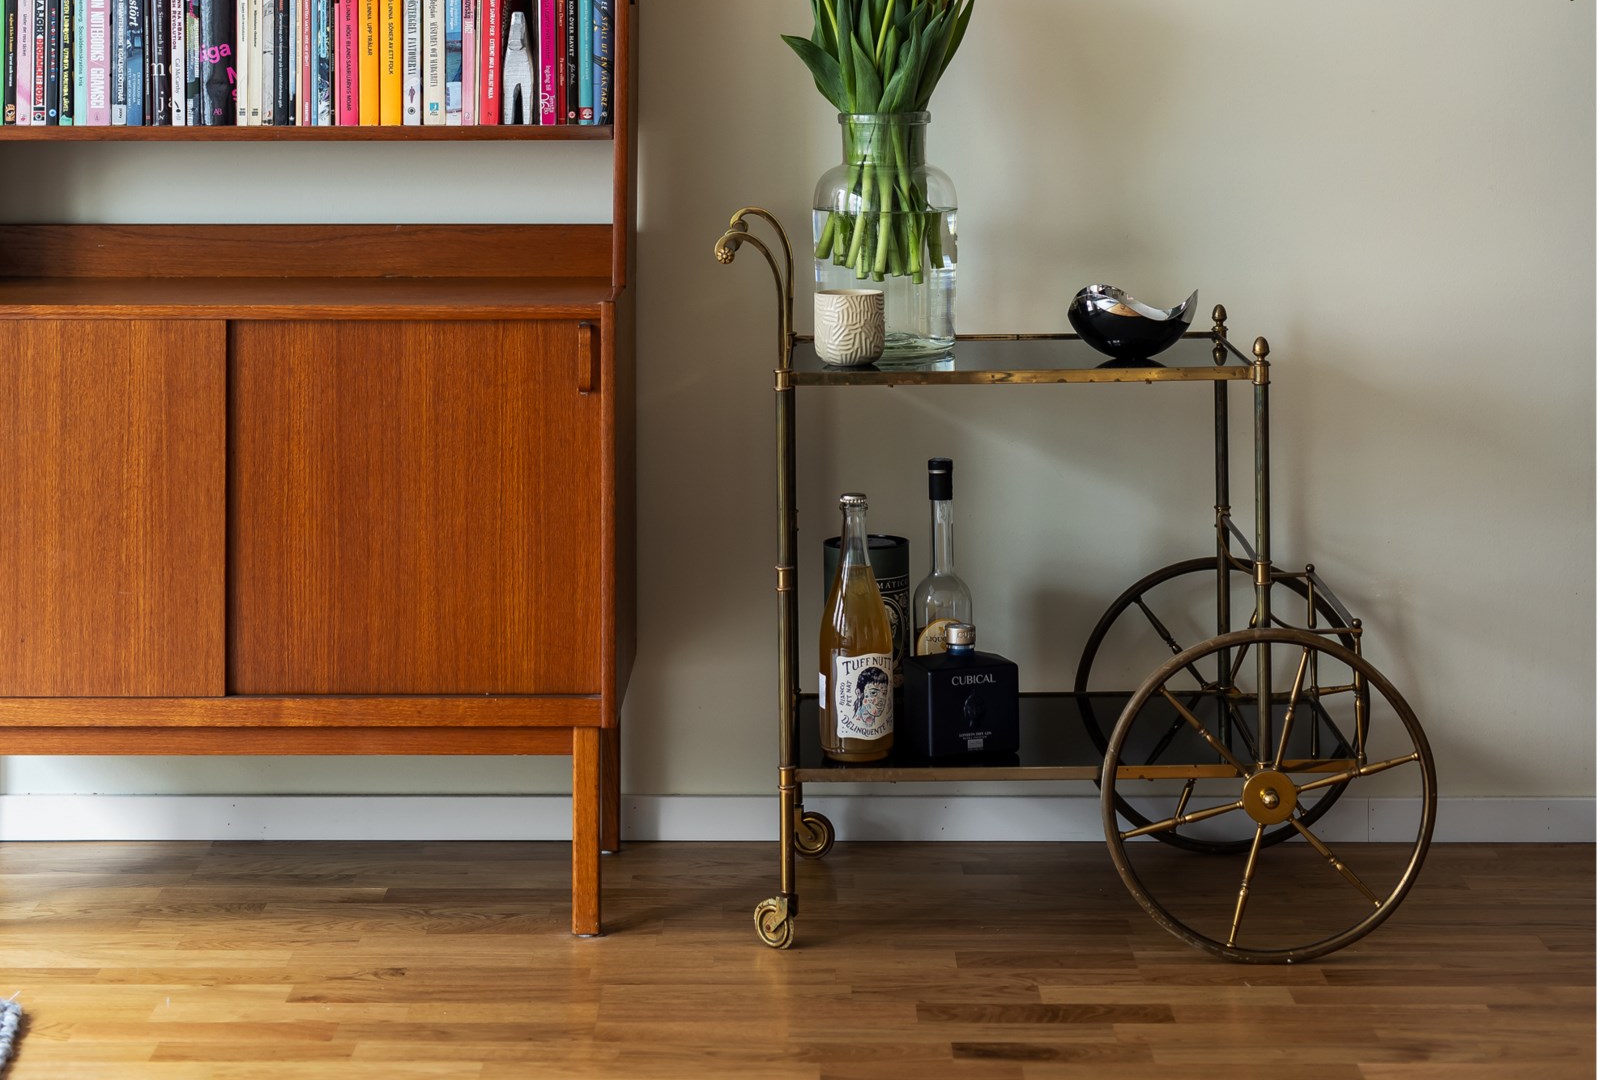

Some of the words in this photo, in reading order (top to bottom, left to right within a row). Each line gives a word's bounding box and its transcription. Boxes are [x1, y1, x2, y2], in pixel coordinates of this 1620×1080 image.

[387, 42, 394, 50] AV
[601, 43, 608, 53] UT
[601, 57, 608, 67] EN
[91, 68, 104, 108] GRAMSCI
[841, 657, 870, 676] TUFF
[951, 673, 997, 686] CUBICAL
[841, 714, 886, 737] DELINQUENTE
